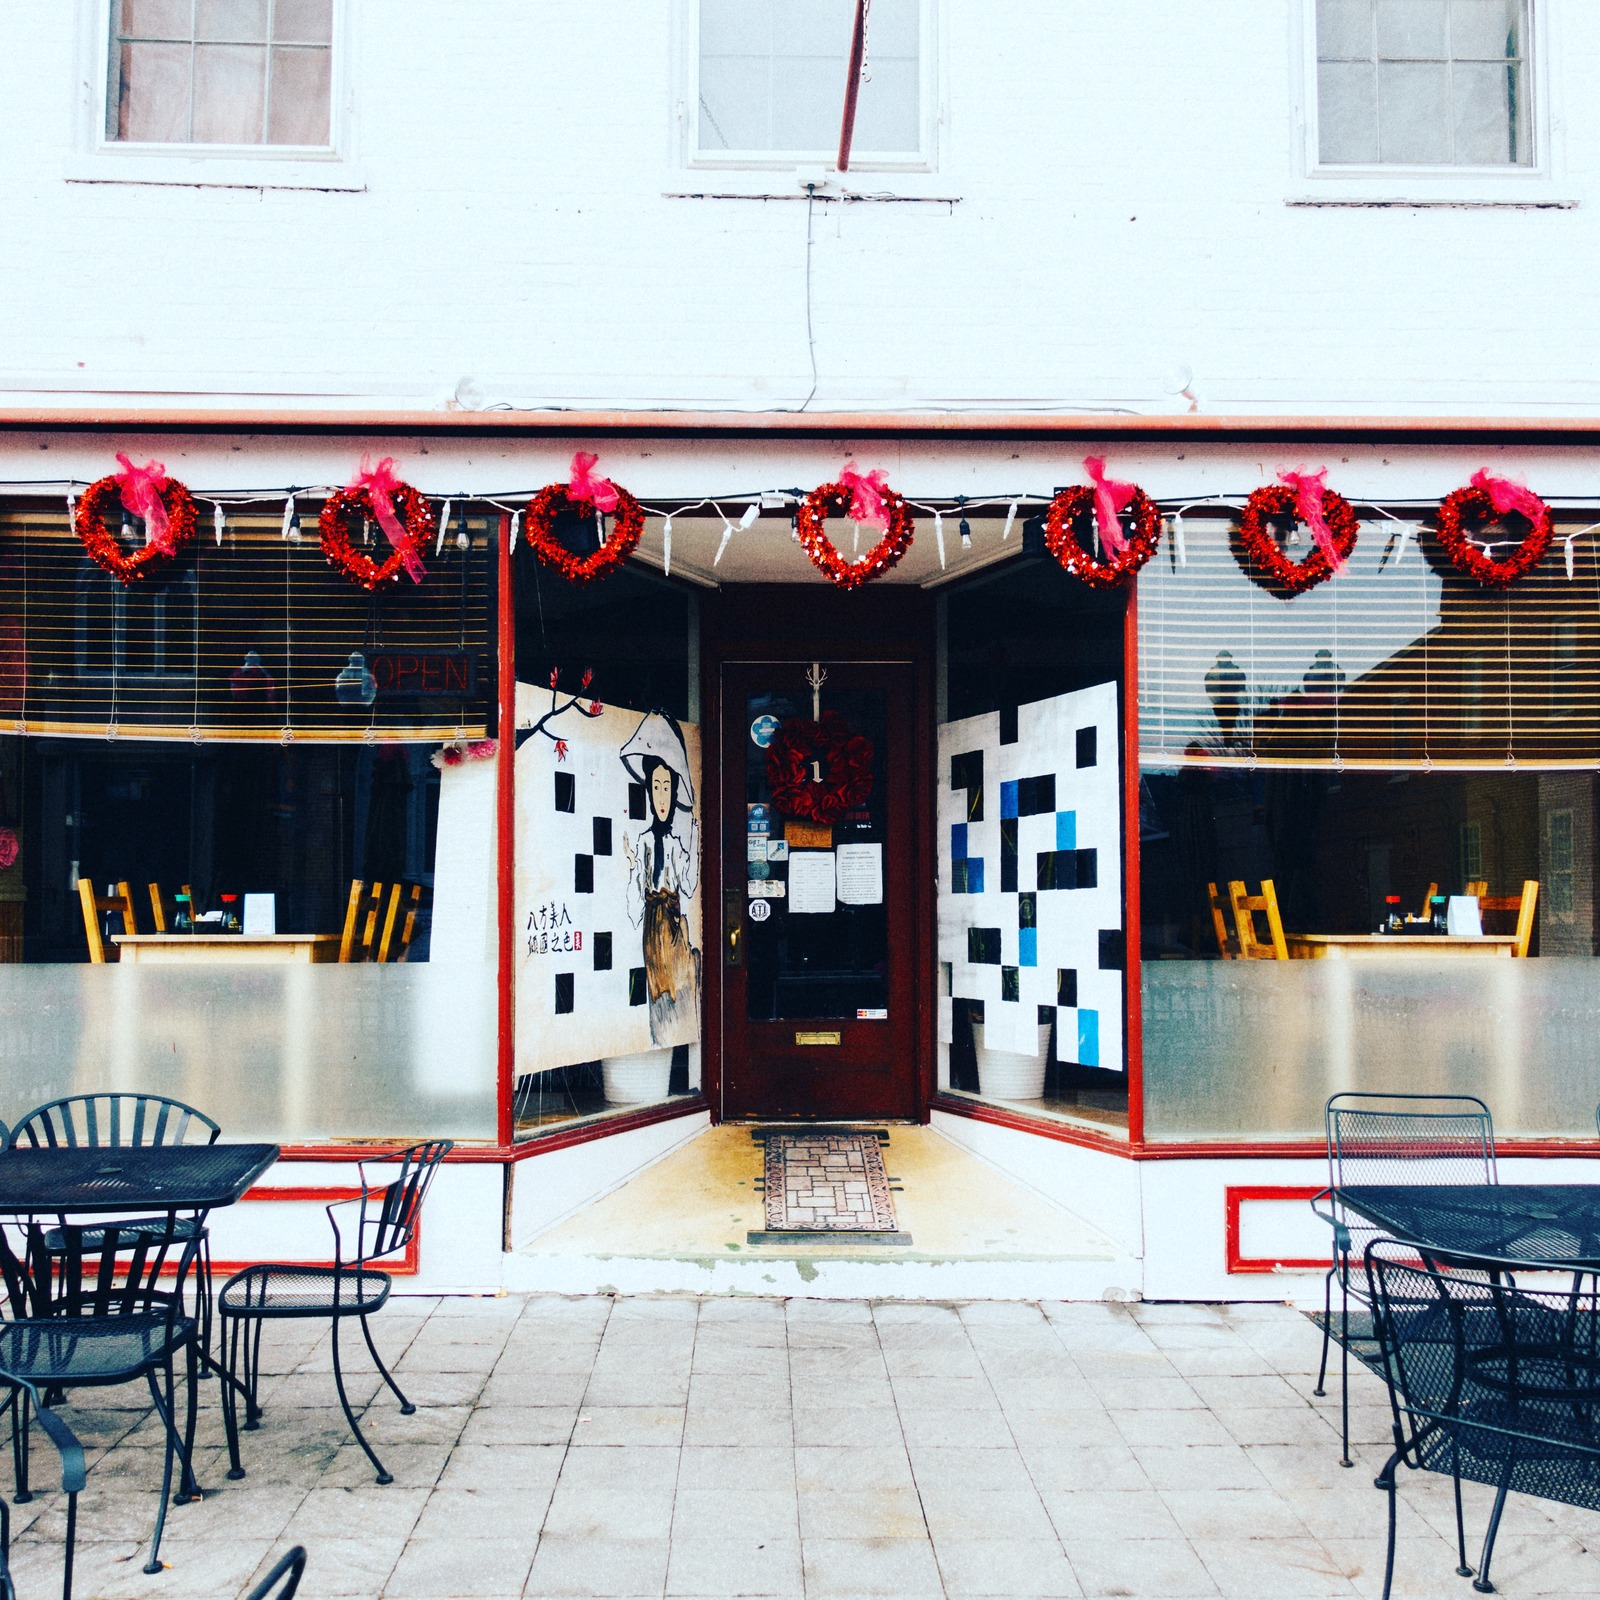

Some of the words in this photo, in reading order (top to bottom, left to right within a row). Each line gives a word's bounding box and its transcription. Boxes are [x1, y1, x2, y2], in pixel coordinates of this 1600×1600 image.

[371, 655, 468, 691] OPEN
[810, 760, 823, 783] 1
[527, 900, 572, 931] 八方美人
